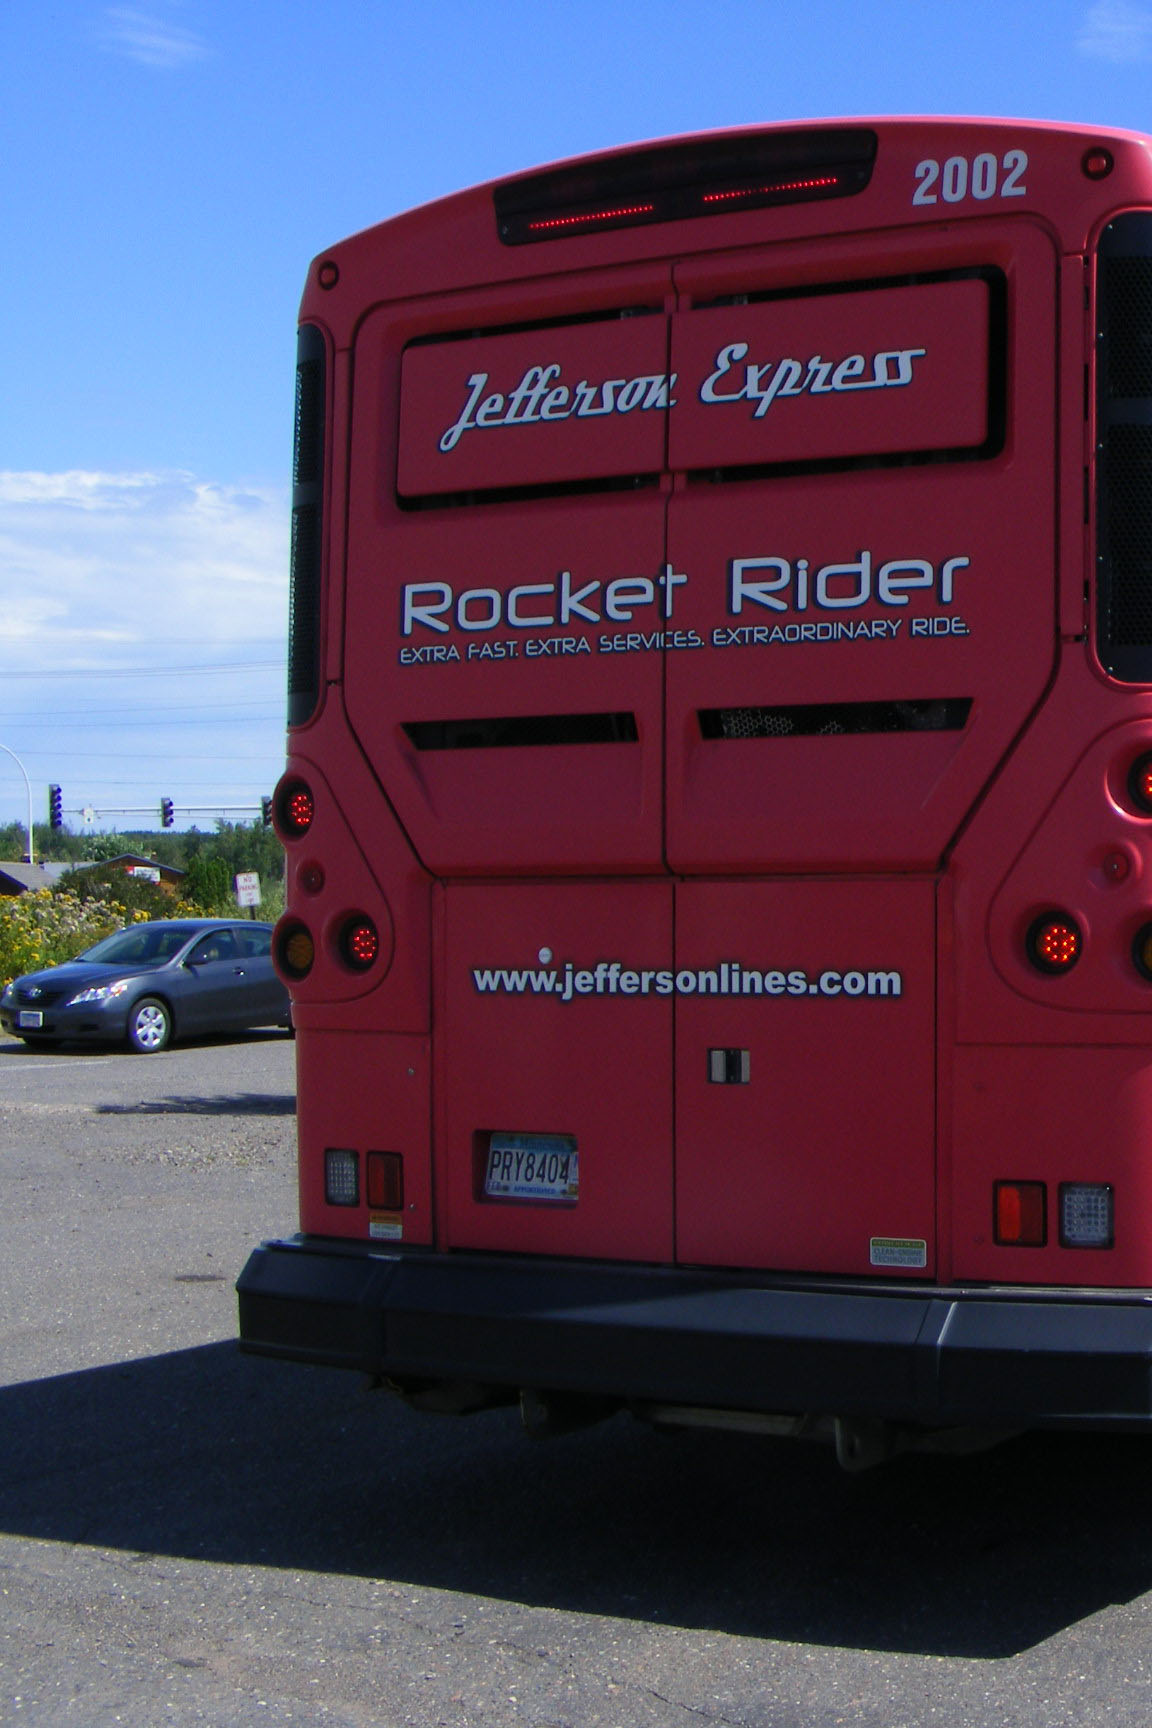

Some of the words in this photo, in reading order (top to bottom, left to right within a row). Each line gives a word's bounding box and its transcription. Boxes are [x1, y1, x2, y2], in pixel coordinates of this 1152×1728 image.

[912, 149, 1029, 206] 2002
[438, 364, 679, 452] Jefferson
[700, 342, 927, 418] Express
[402, 562, 689, 635] Rocket
[730, 550, 971, 615] Rider
[400, 644, 461, 664] EXTRA
[468, 640, 519, 660] FAST.
[525, 636, 591, 656] EXTRA
[599, 629, 705, 652] SERVICES.
[712, 619, 902, 647] EXTRAORDINARY
[911, 616, 971, 636] RIDE.
[473, 962, 902, 1000] www.jeffersonlines.com
[489, 1150, 571, 1184] PRY8404
